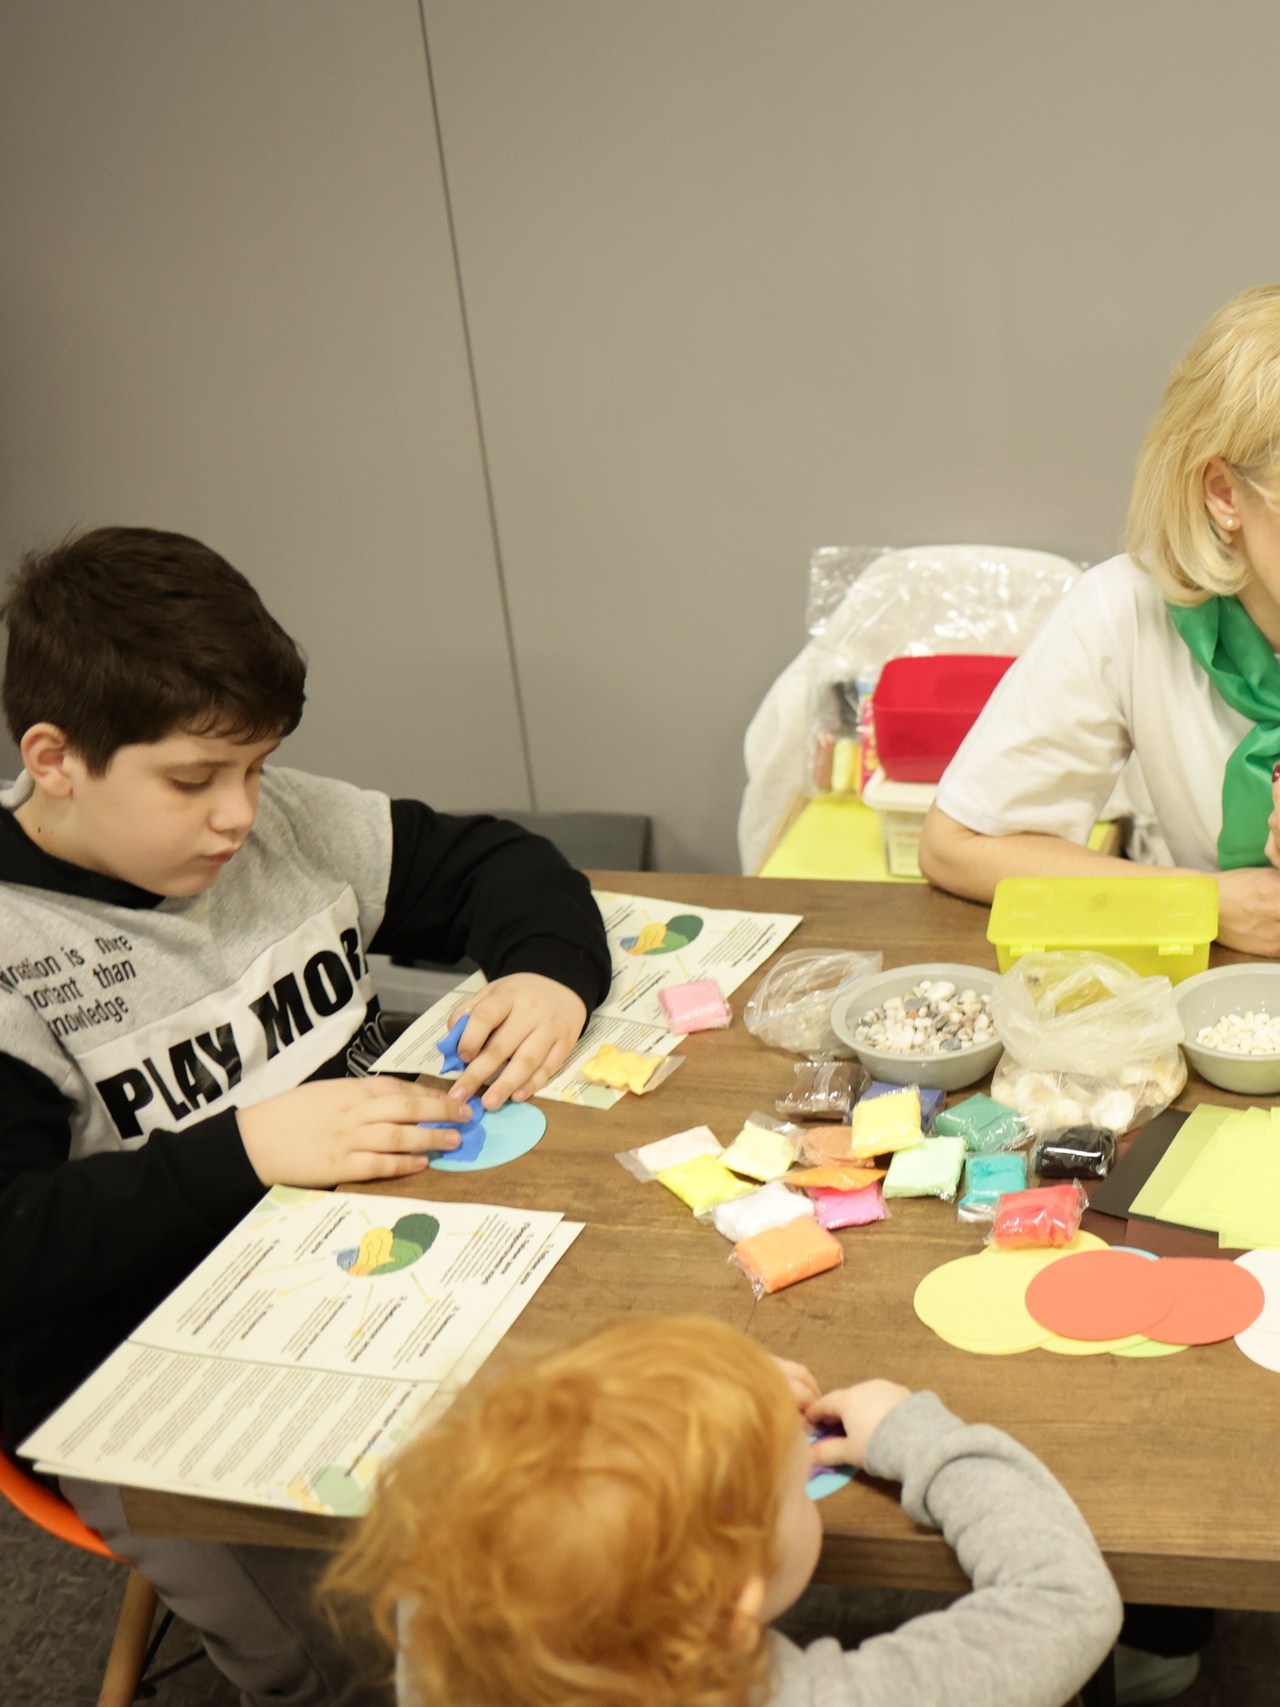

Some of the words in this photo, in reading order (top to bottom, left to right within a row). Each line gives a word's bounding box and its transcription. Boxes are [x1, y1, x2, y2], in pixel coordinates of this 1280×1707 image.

[59, 945, 86, 968] is
[92, 960, 138, 990] than
[95, 1022, 243, 1140] PLAY
